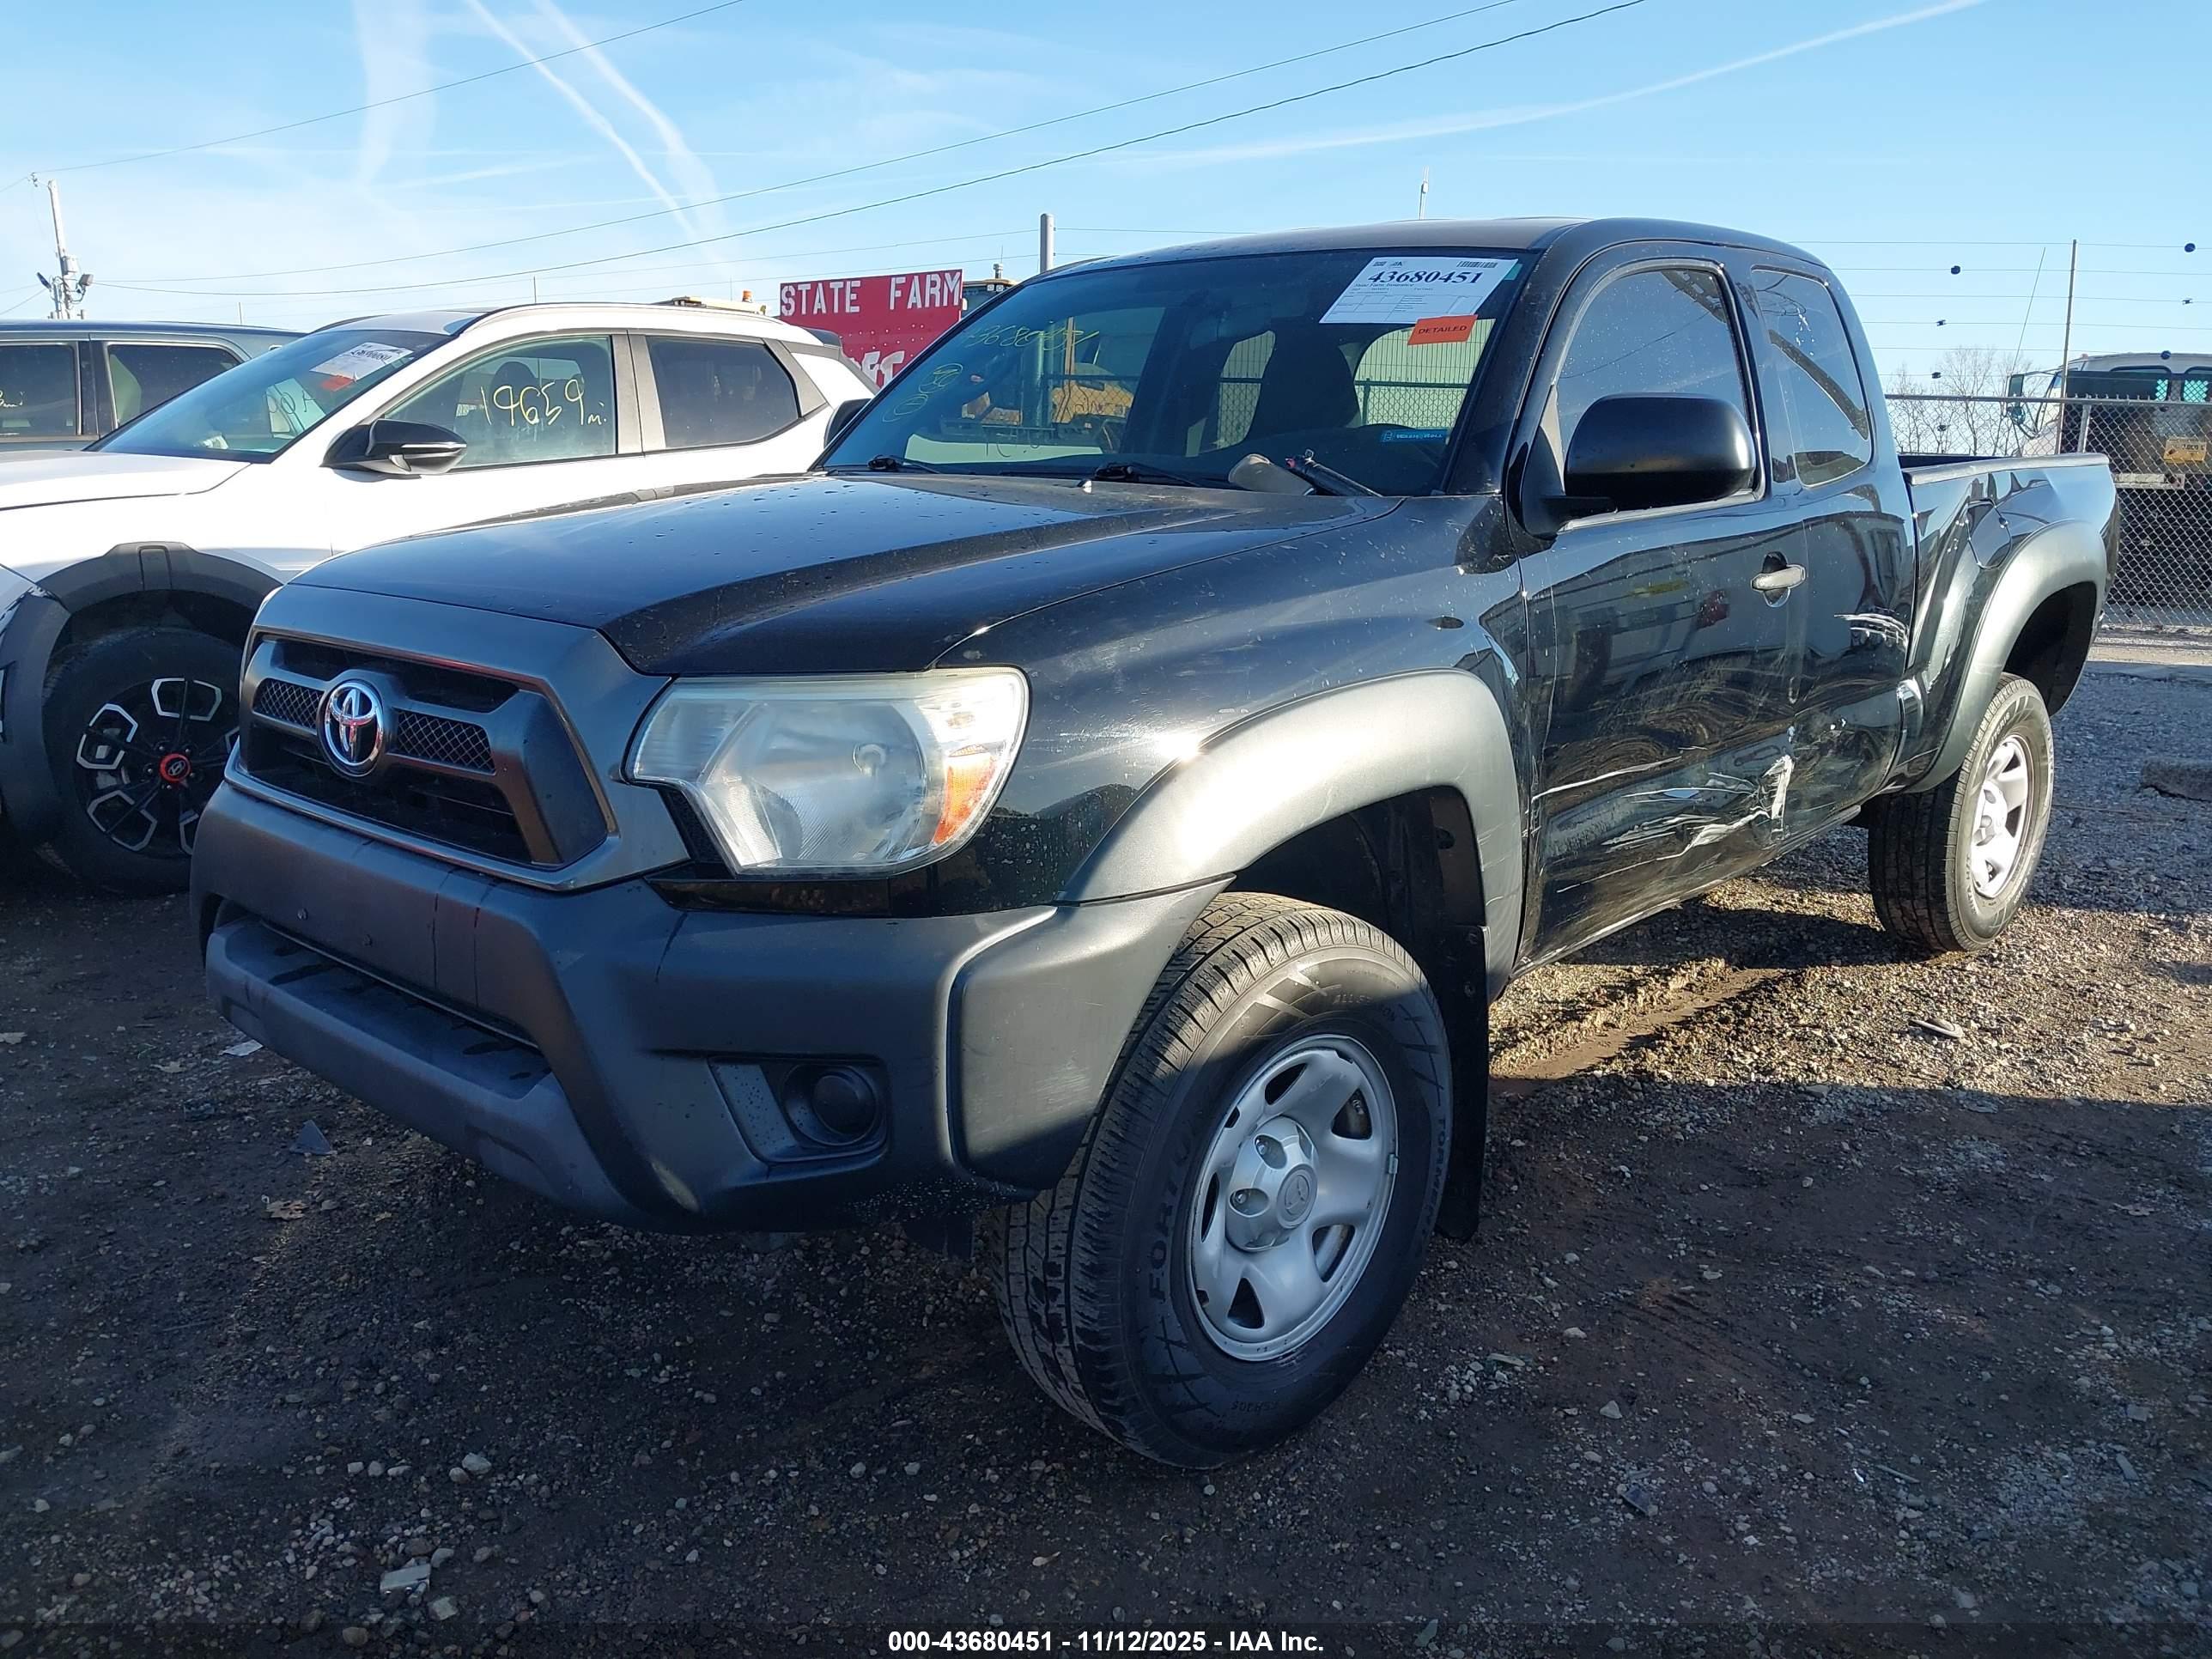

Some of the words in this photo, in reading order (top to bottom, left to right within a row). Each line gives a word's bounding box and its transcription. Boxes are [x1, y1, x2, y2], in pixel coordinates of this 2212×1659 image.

[1367, 270, 1484, 284] 43680451
[780, 280, 861, 317] STATE
[889, 271, 963, 311] FARM
[1418, 325, 1468, 335] DETAILED
